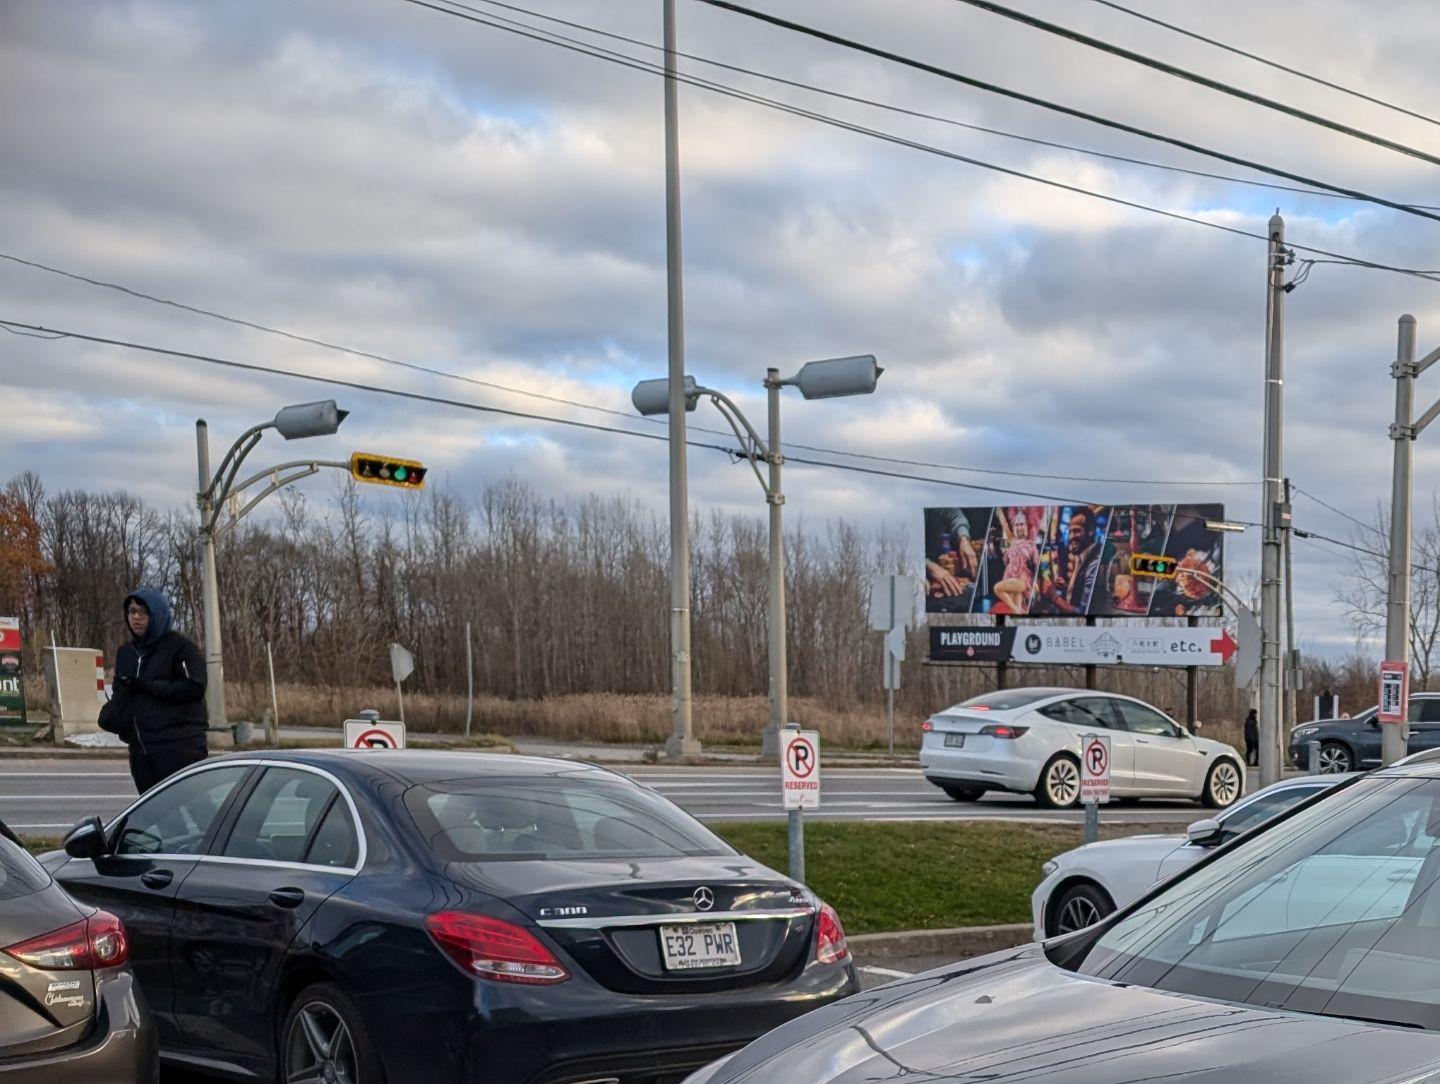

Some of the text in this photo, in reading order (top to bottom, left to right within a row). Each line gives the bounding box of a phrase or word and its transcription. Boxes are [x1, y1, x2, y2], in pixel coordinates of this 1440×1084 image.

[940, 631, 1001, 646] PLAYGROUND
[1046, 636, 1085, 648] BABEL
[1170, 640, 1202, 653] etc.
[785, 781, 819, 790] RESERVED
[666, 933, 734, 957] E32 PWR
